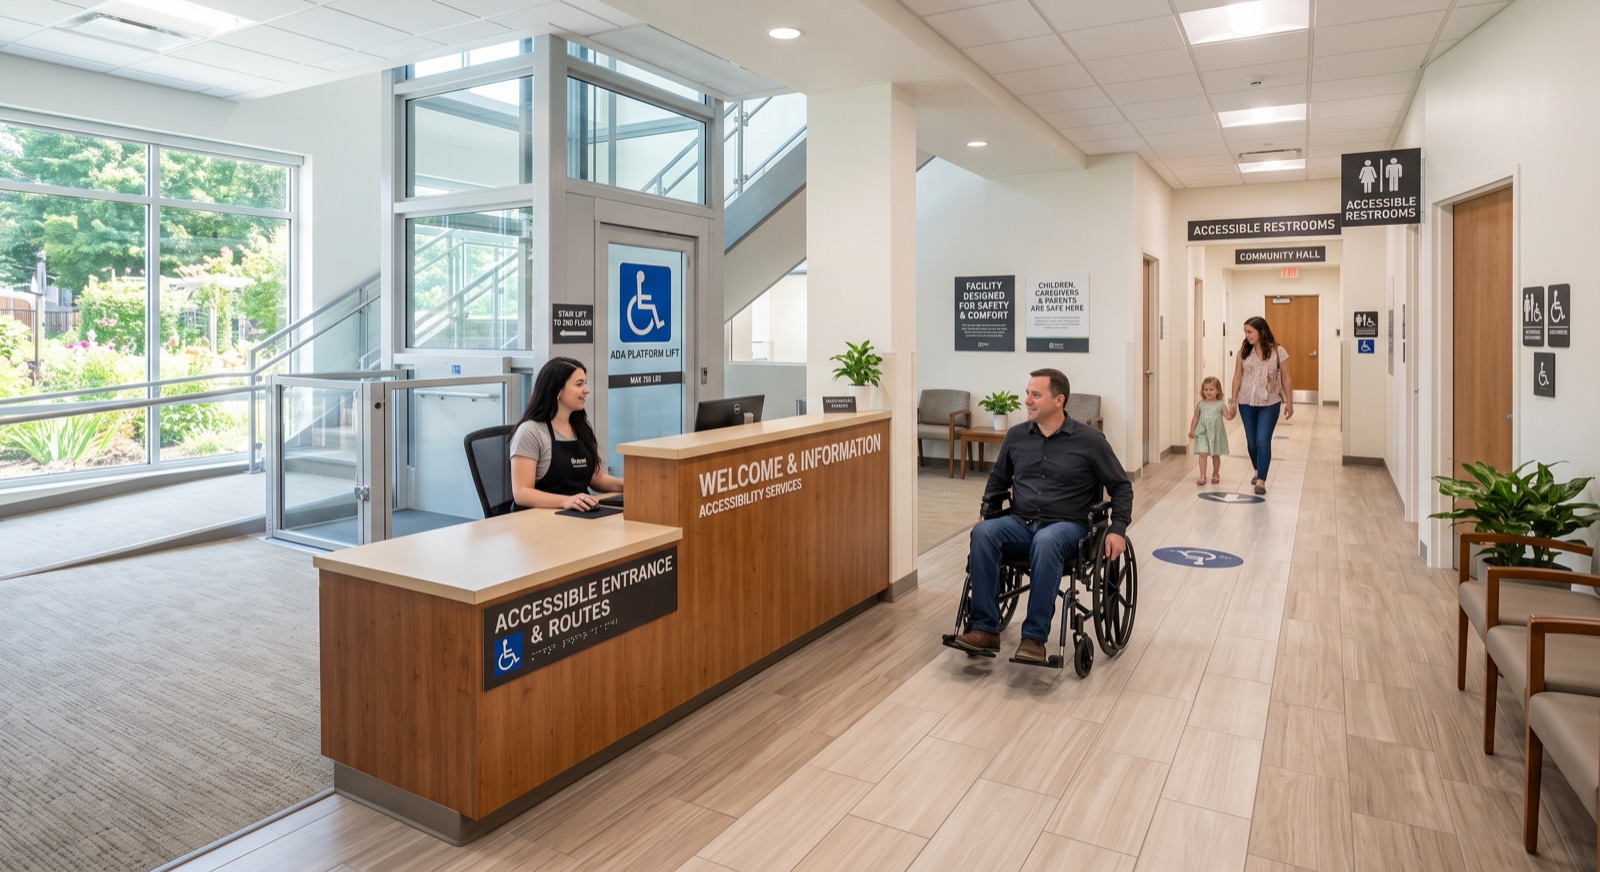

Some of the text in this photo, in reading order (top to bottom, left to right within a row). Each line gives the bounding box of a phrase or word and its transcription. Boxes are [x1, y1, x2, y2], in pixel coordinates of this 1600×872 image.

[1346, 196, 1416, 210] ACCESSIBLE
[1346, 208, 1416, 221] RESTROOMS
[1193, 220, 1335, 236] ACCESSIBLE RESTROOMS
[1240, 250, 1320, 262] COMMUNITY HALL
[966, 281, 1002, 290] FACILITY
[963, 291, 1005, 300] DESIGNED
[978, 301, 1009, 310] SAFETY
[968, 311, 1008, 319] COMFORT
[610, 348, 679, 359] ADA PLATFORM LIFT
[699, 433, 881, 498] WELCOME & INFORMATION
[699, 478, 802, 518] ACCESSIBILITY SERVICES
[495, 555, 673, 634] ACCESSIBLE ENTRANCE
[530, 625, 543, 644] &
[549, 599, 610, 638] ROUTES
